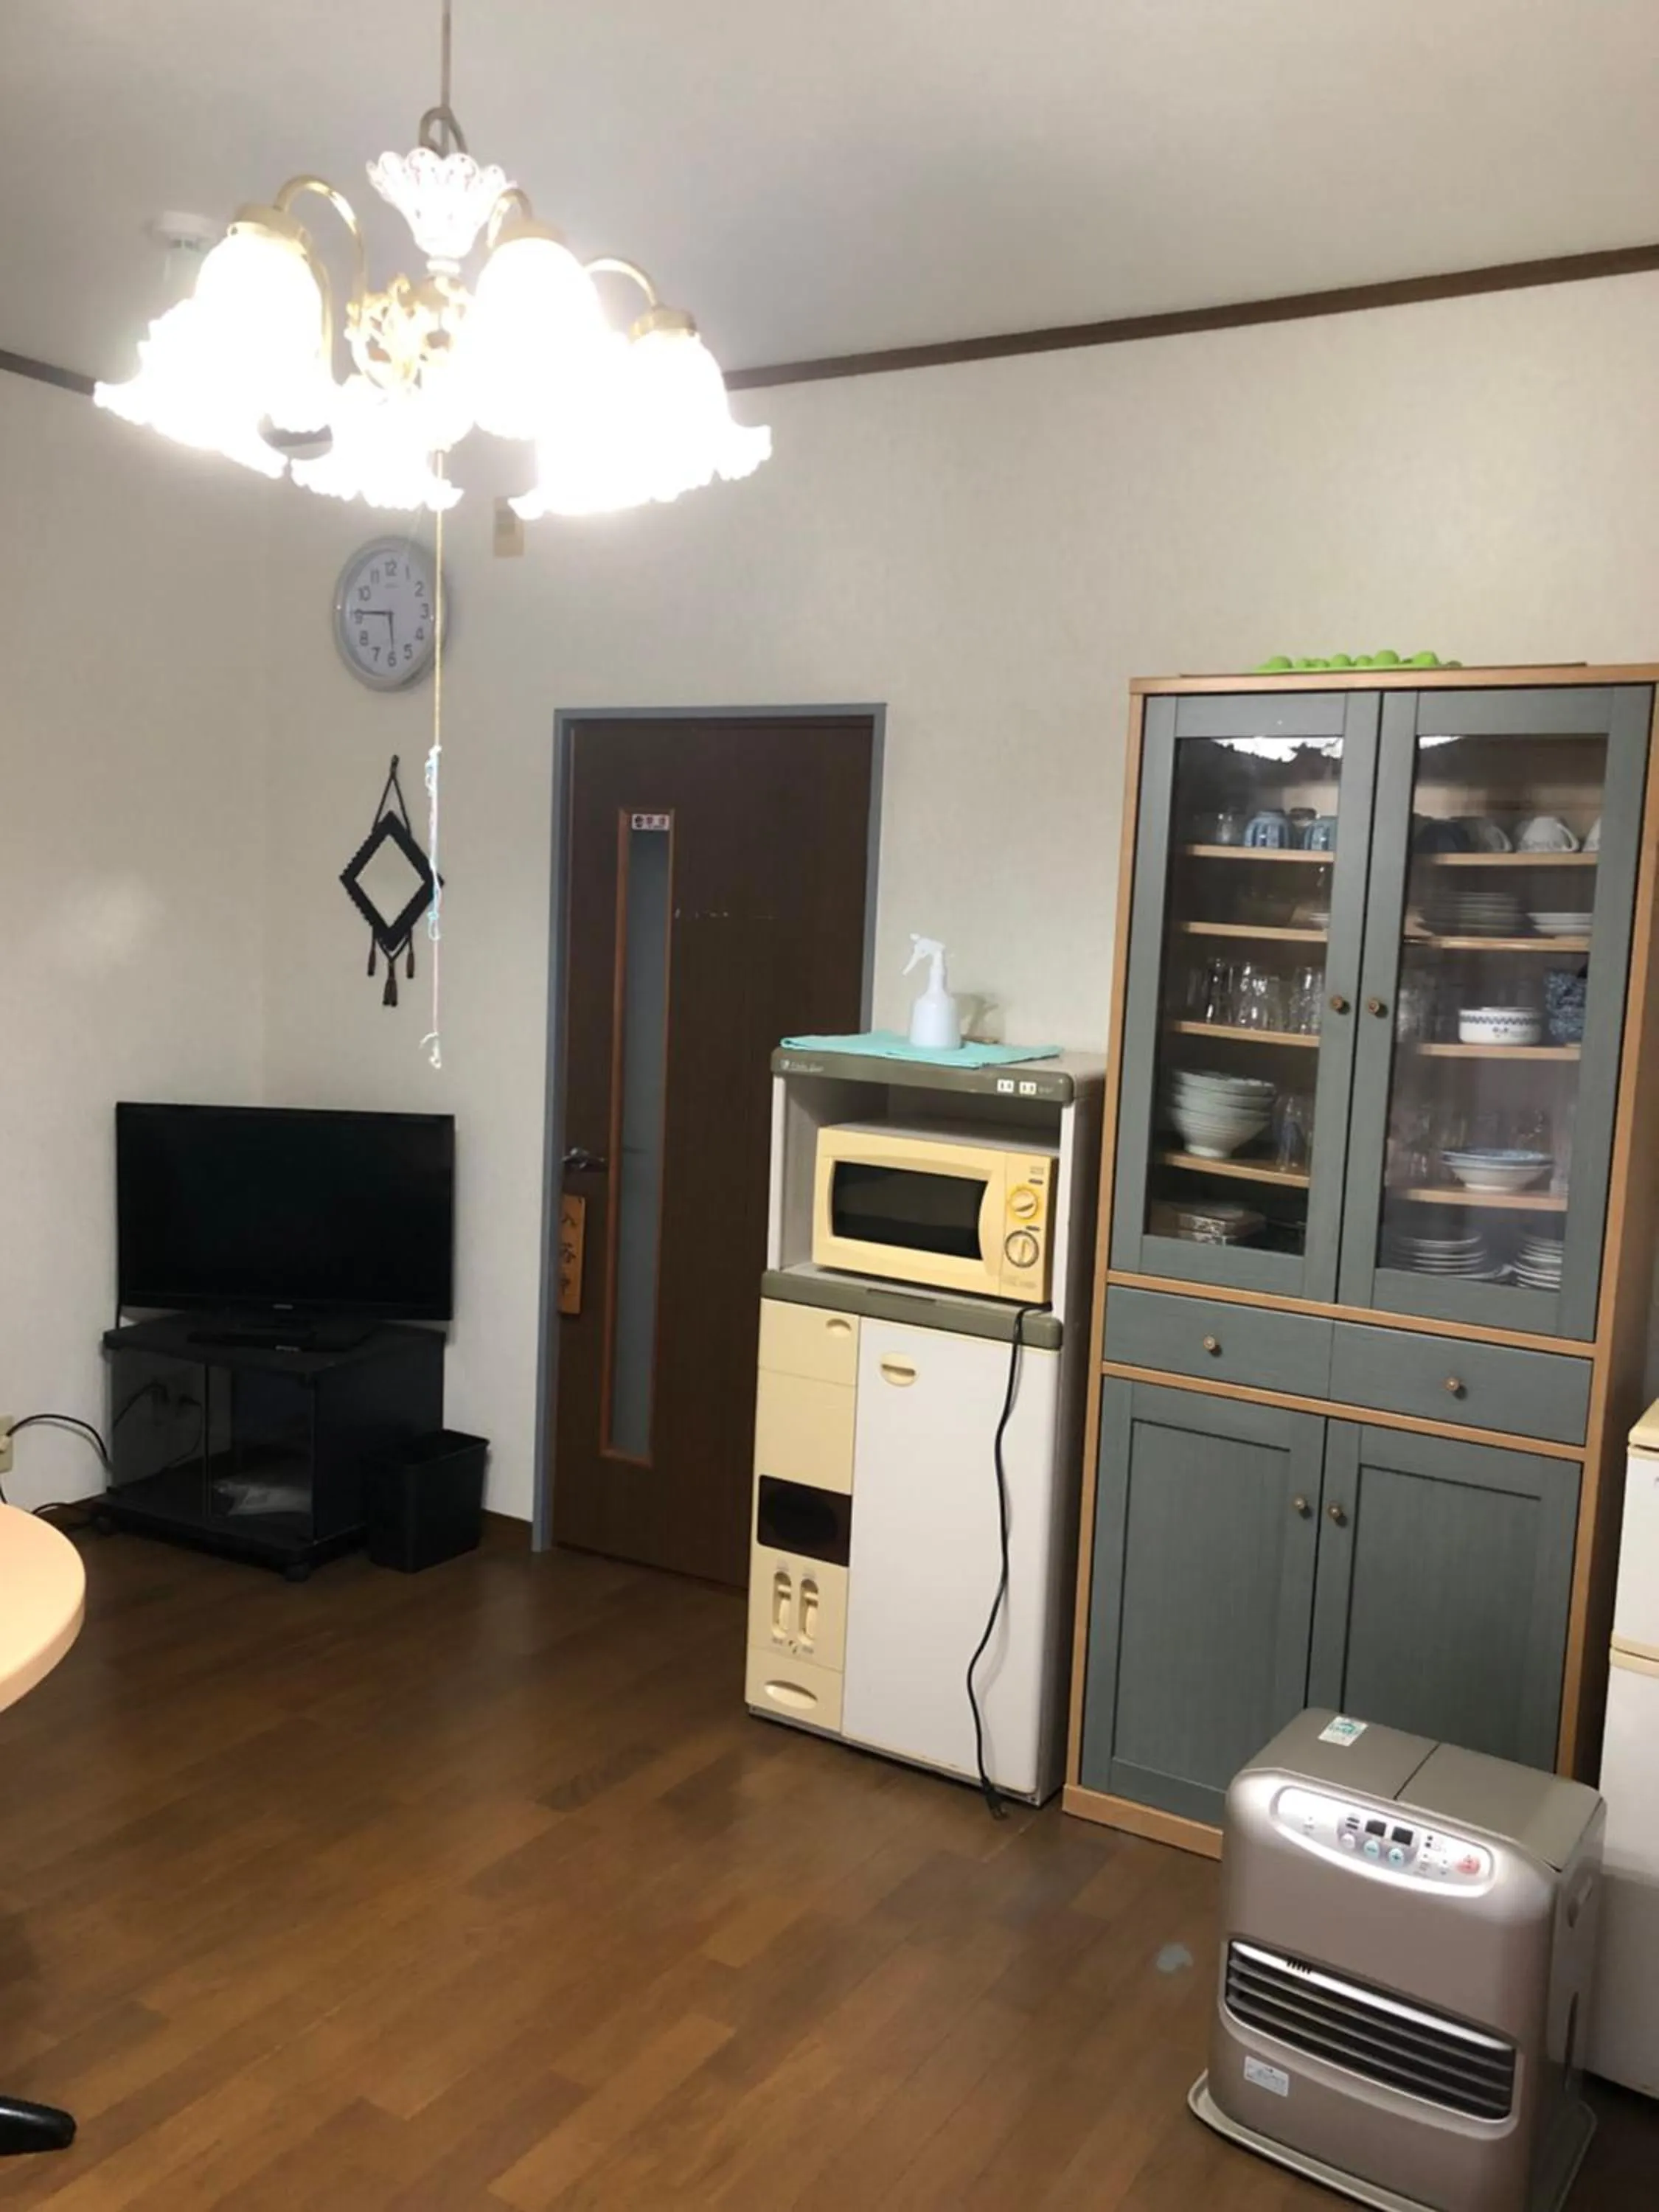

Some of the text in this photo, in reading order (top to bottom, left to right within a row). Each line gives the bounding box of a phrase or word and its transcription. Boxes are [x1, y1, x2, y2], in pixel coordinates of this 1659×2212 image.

[384, 557, 397, 577] 12
[405, 564, 411, 580] 1
[358, 585, 372, 602] 10
[414, 580, 424, 597] 2
[420, 602, 429, 620] 3
[358, 630, 369, 647] 8
[414, 627, 425, 641] 4
[372, 646, 381, 662] 7
[387, 650, 397, 667] 6
[403, 643, 413, 660] 5
